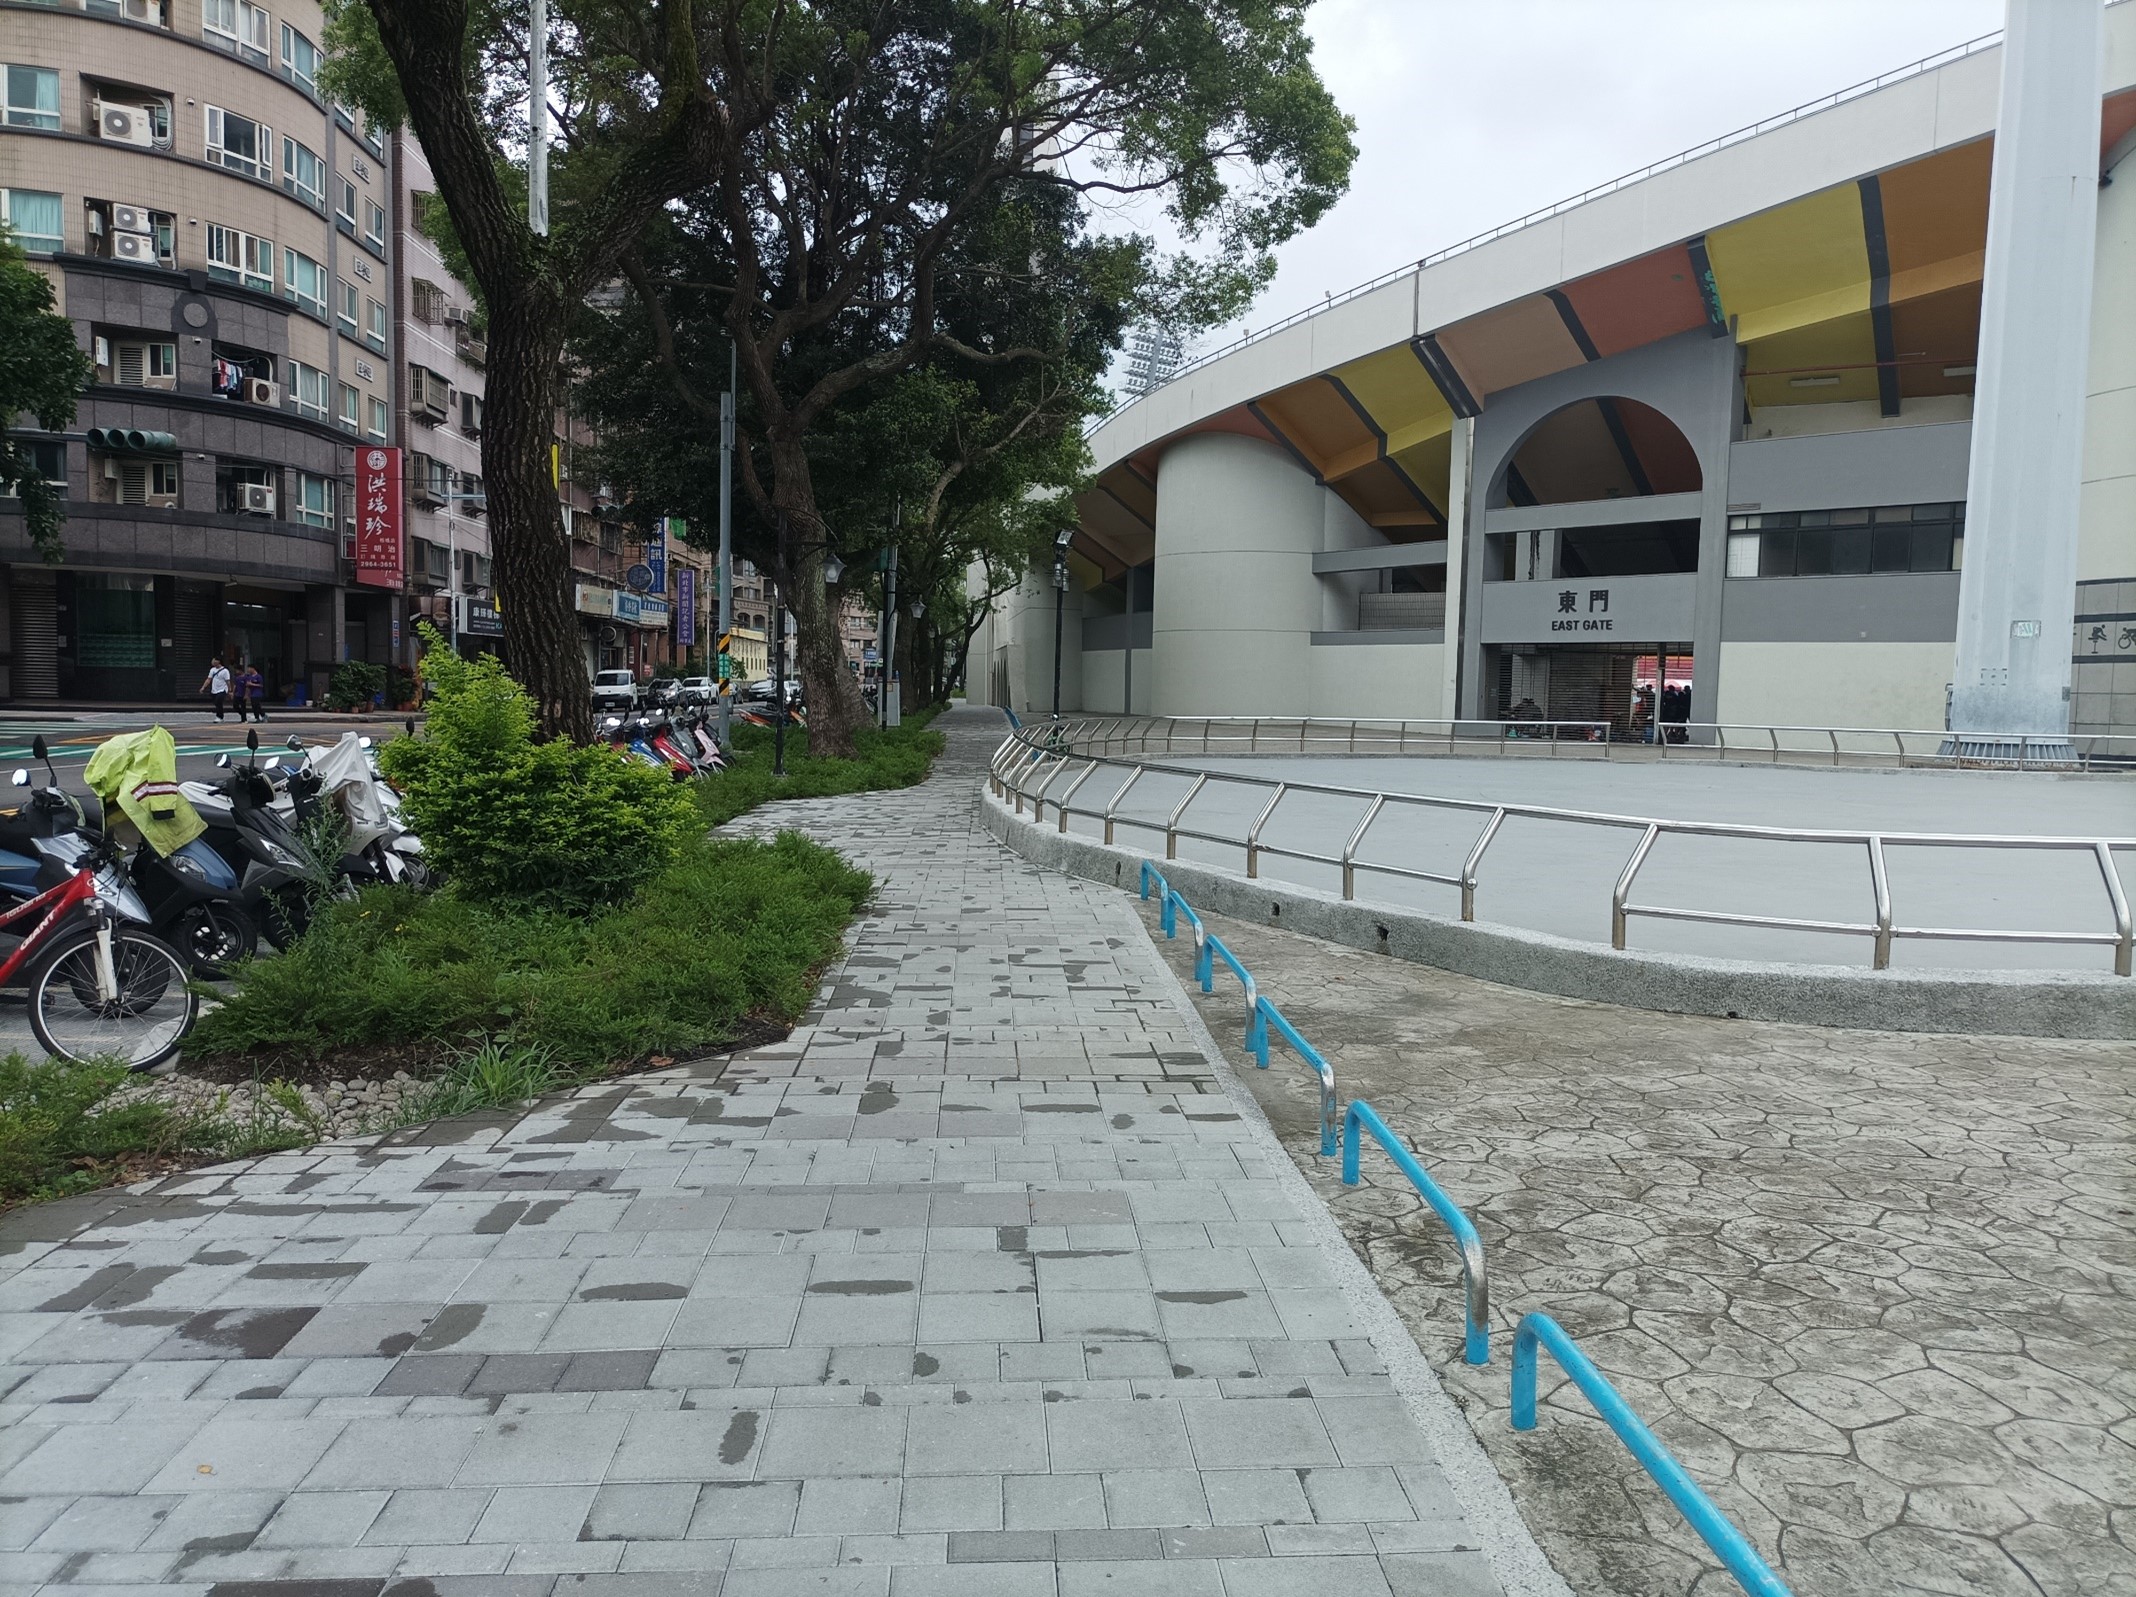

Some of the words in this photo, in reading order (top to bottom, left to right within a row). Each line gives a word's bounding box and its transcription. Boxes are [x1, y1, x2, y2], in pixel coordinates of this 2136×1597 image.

[364, 472, 392, 540] 洪瑞珍
[360, 544, 396, 554] 三明治
[1558, 589, 1610, 614] 東門
[1551, 620, 1580, 631] EAST
[1583, 619, 1613, 631] GATE
[20, 909, 56, 951] GIANT
